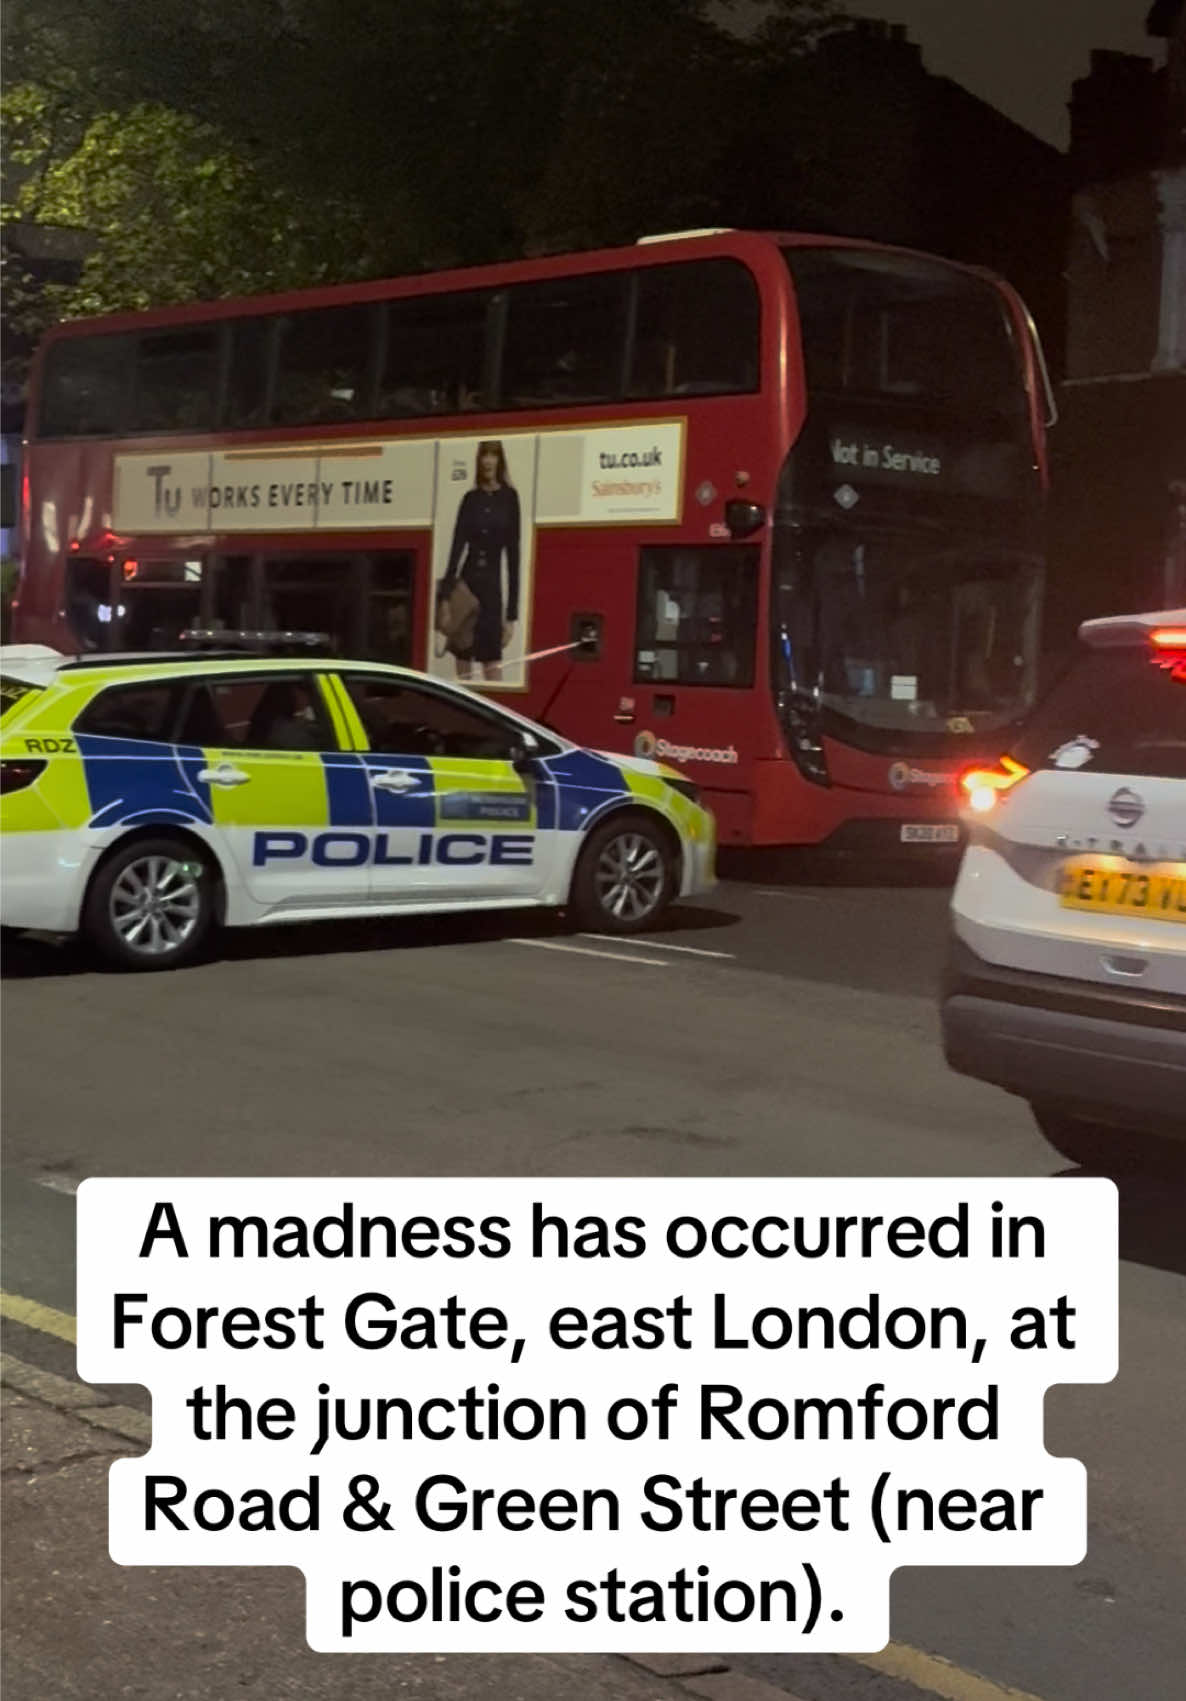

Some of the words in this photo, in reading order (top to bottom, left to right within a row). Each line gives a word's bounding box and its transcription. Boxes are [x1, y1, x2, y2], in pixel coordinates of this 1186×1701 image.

[600, 446, 662, 468] tu.co.uk
[881, 445, 941, 475] Service
[146, 465, 182, 518] Tu
[192, 485, 261, 509] WORKS
[269, 482, 334, 507] EVERY
[342, 480, 394, 504] TIME
[24, 738, 77, 753] RDZ
[656, 738, 738, 763] Stagecoach
[253, 831, 536, 867] POLICE
